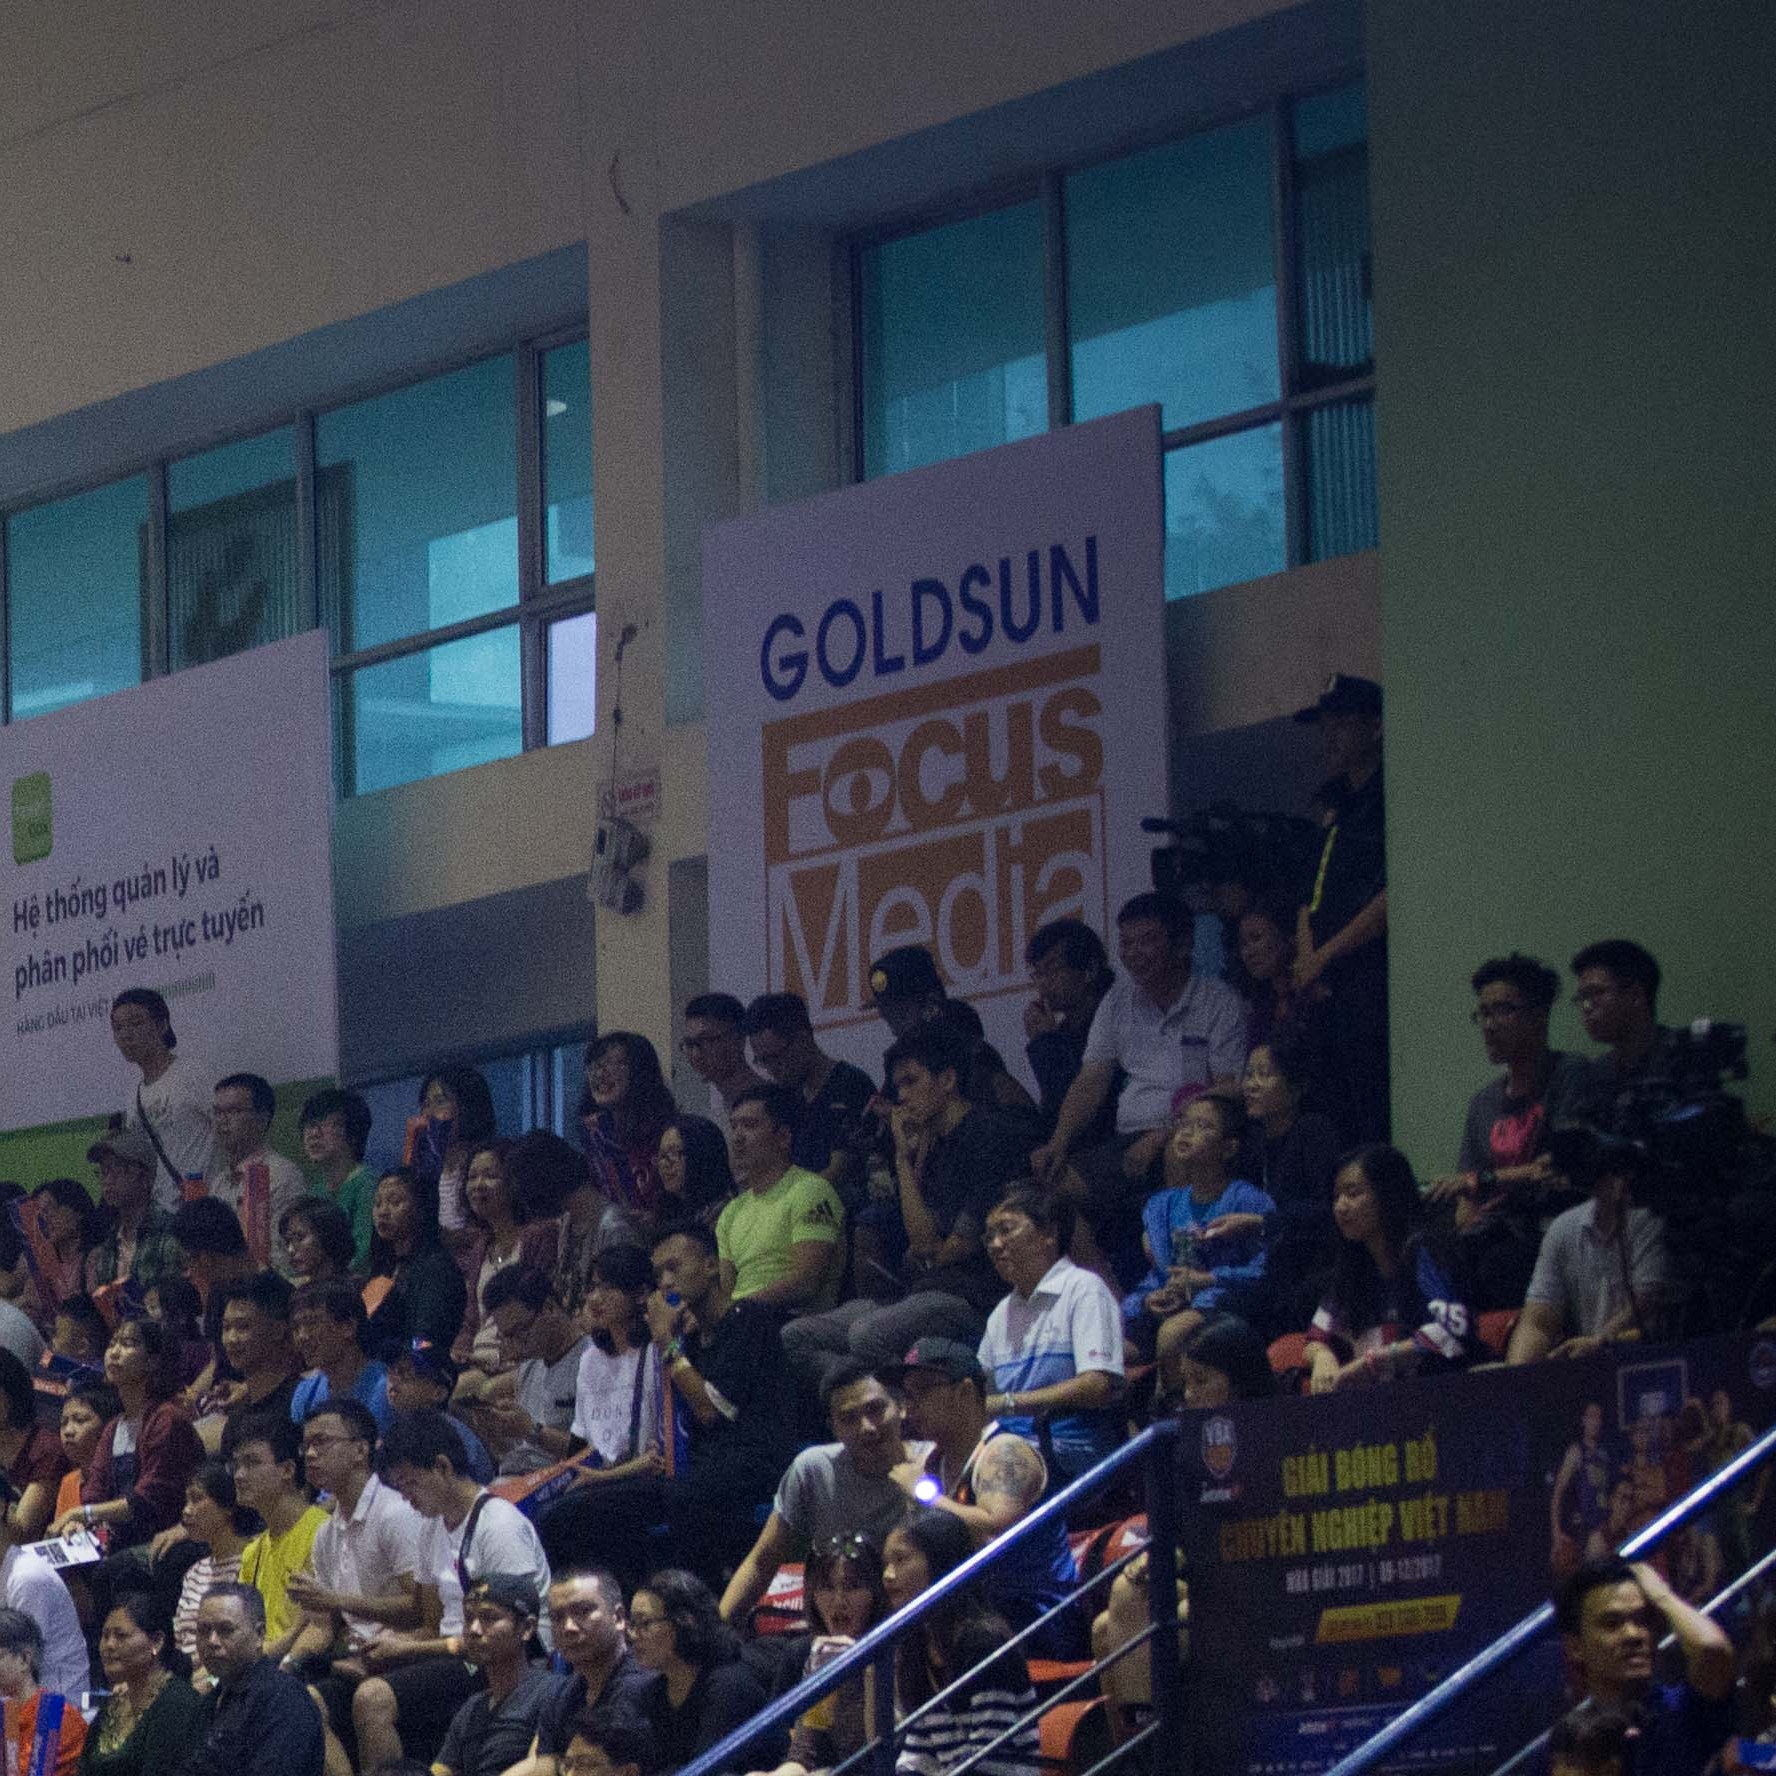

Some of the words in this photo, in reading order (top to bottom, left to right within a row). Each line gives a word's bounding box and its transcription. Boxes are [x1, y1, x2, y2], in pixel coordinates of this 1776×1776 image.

[760, 536, 1100, 700] GOLDSUN
[14, 900, 41, 939] Hệ
[47, 876, 108, 923] thống
[112, 862, 167, 914] quản
[172, 853, 190, 898] lý
[197, 846, 220, 884] và
[72, 927, 119, 985] phối
[124, 923, 148, 962] vé
[152, 918, 197, 960] trực
[201, 890, 265, 945] tuyến
